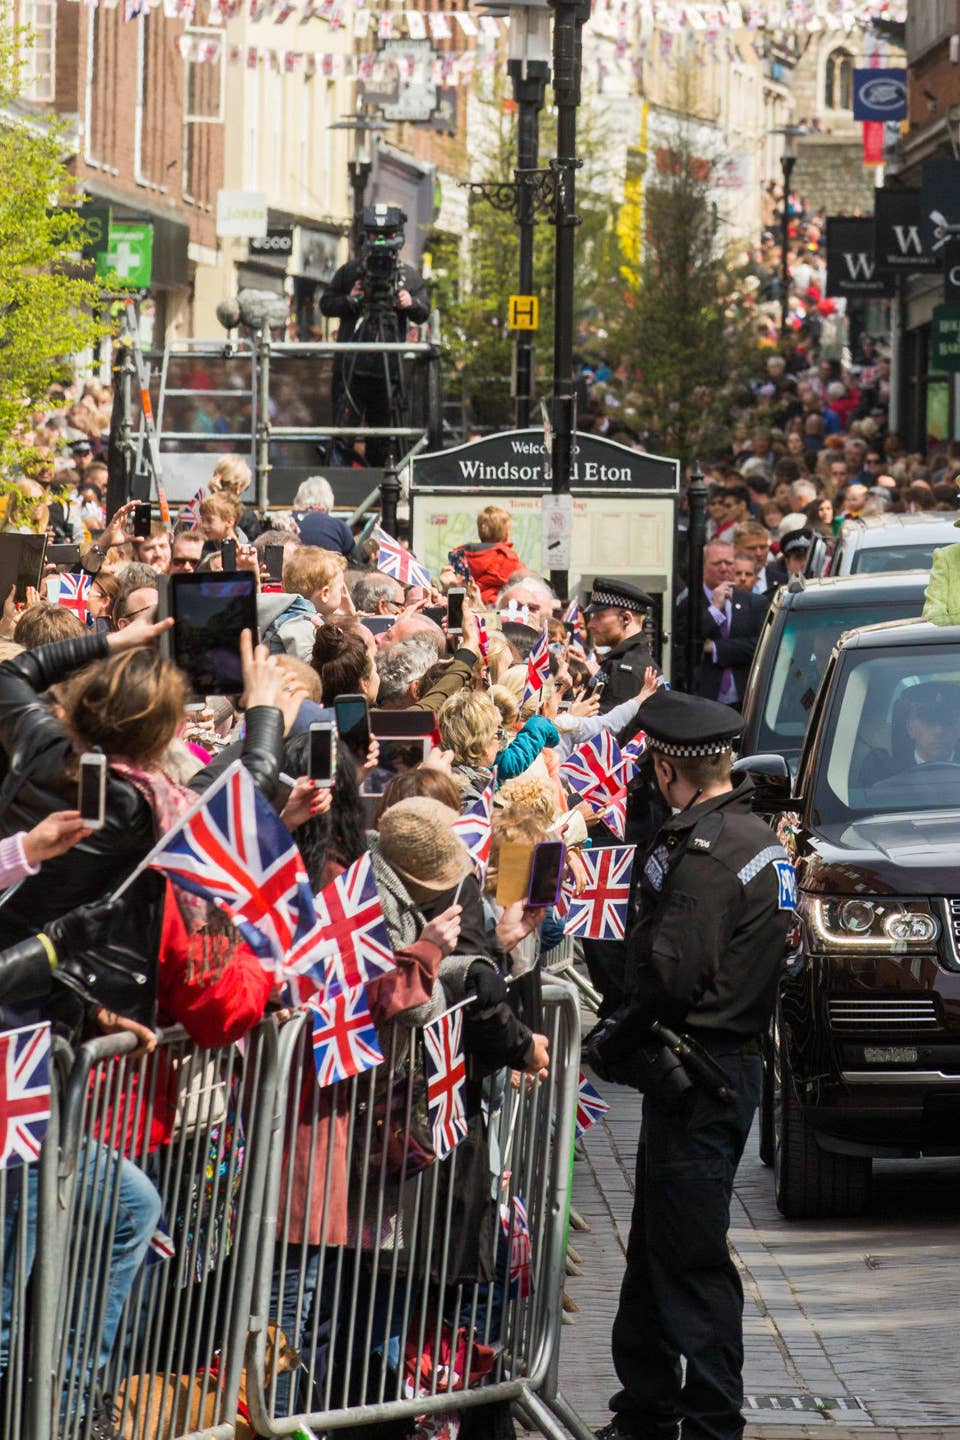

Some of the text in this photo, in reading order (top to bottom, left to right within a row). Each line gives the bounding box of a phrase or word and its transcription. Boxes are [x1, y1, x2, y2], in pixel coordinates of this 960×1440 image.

[843, 252, 876, 279] W
[513, 300, 534, 326] H
[459, 461, 632, 481] Windsor ad Eton
